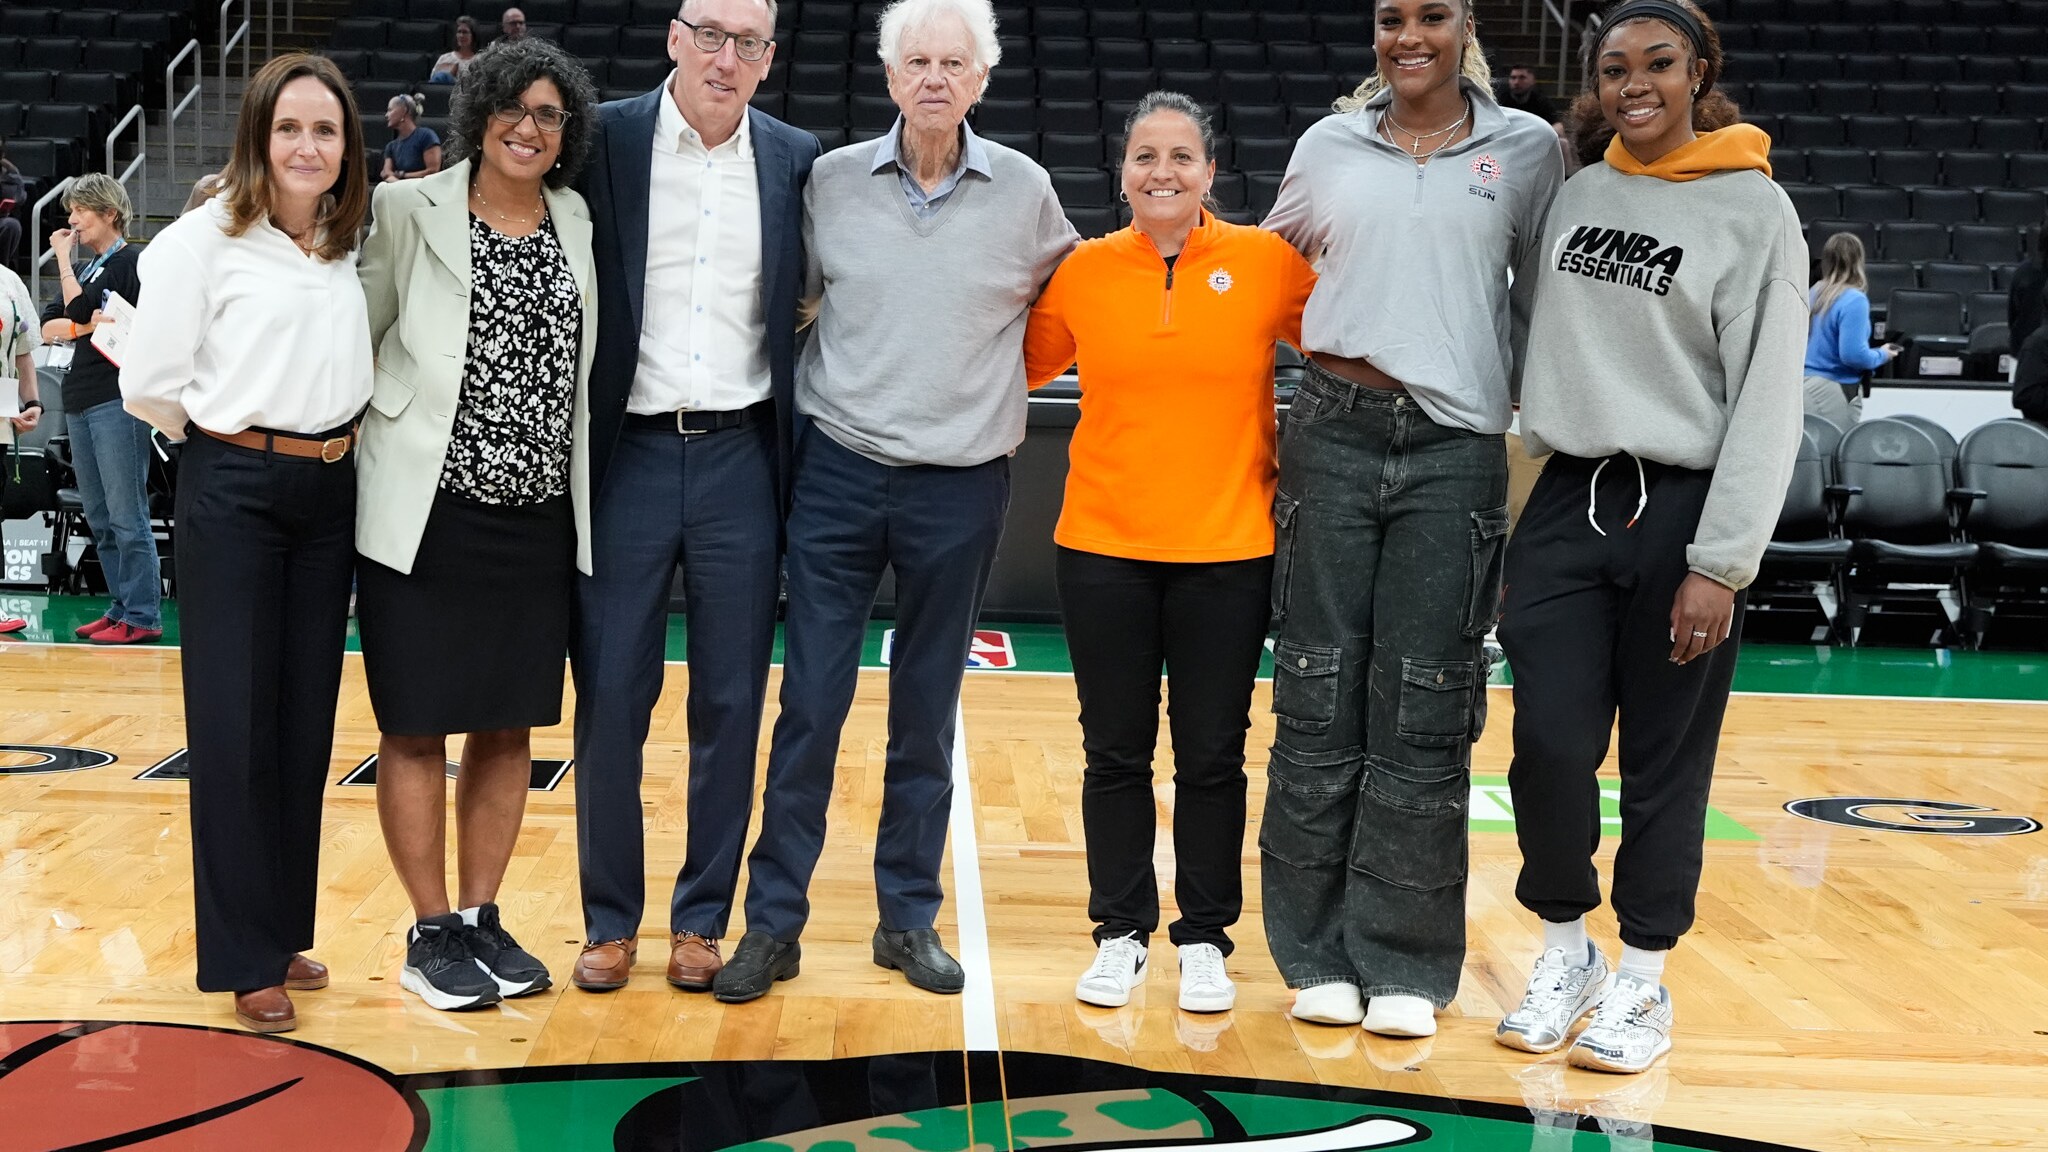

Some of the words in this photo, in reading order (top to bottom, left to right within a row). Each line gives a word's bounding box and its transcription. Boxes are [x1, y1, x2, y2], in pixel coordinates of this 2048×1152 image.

[1469, 188, 1496, 202] SUN
[1566, 226, 1684, 276] WNBA
[1557, 251, 1673, 297] ESSENTIALS
[4, 549, 37, 564] ON
[1782, 797, 2043, 836] G
